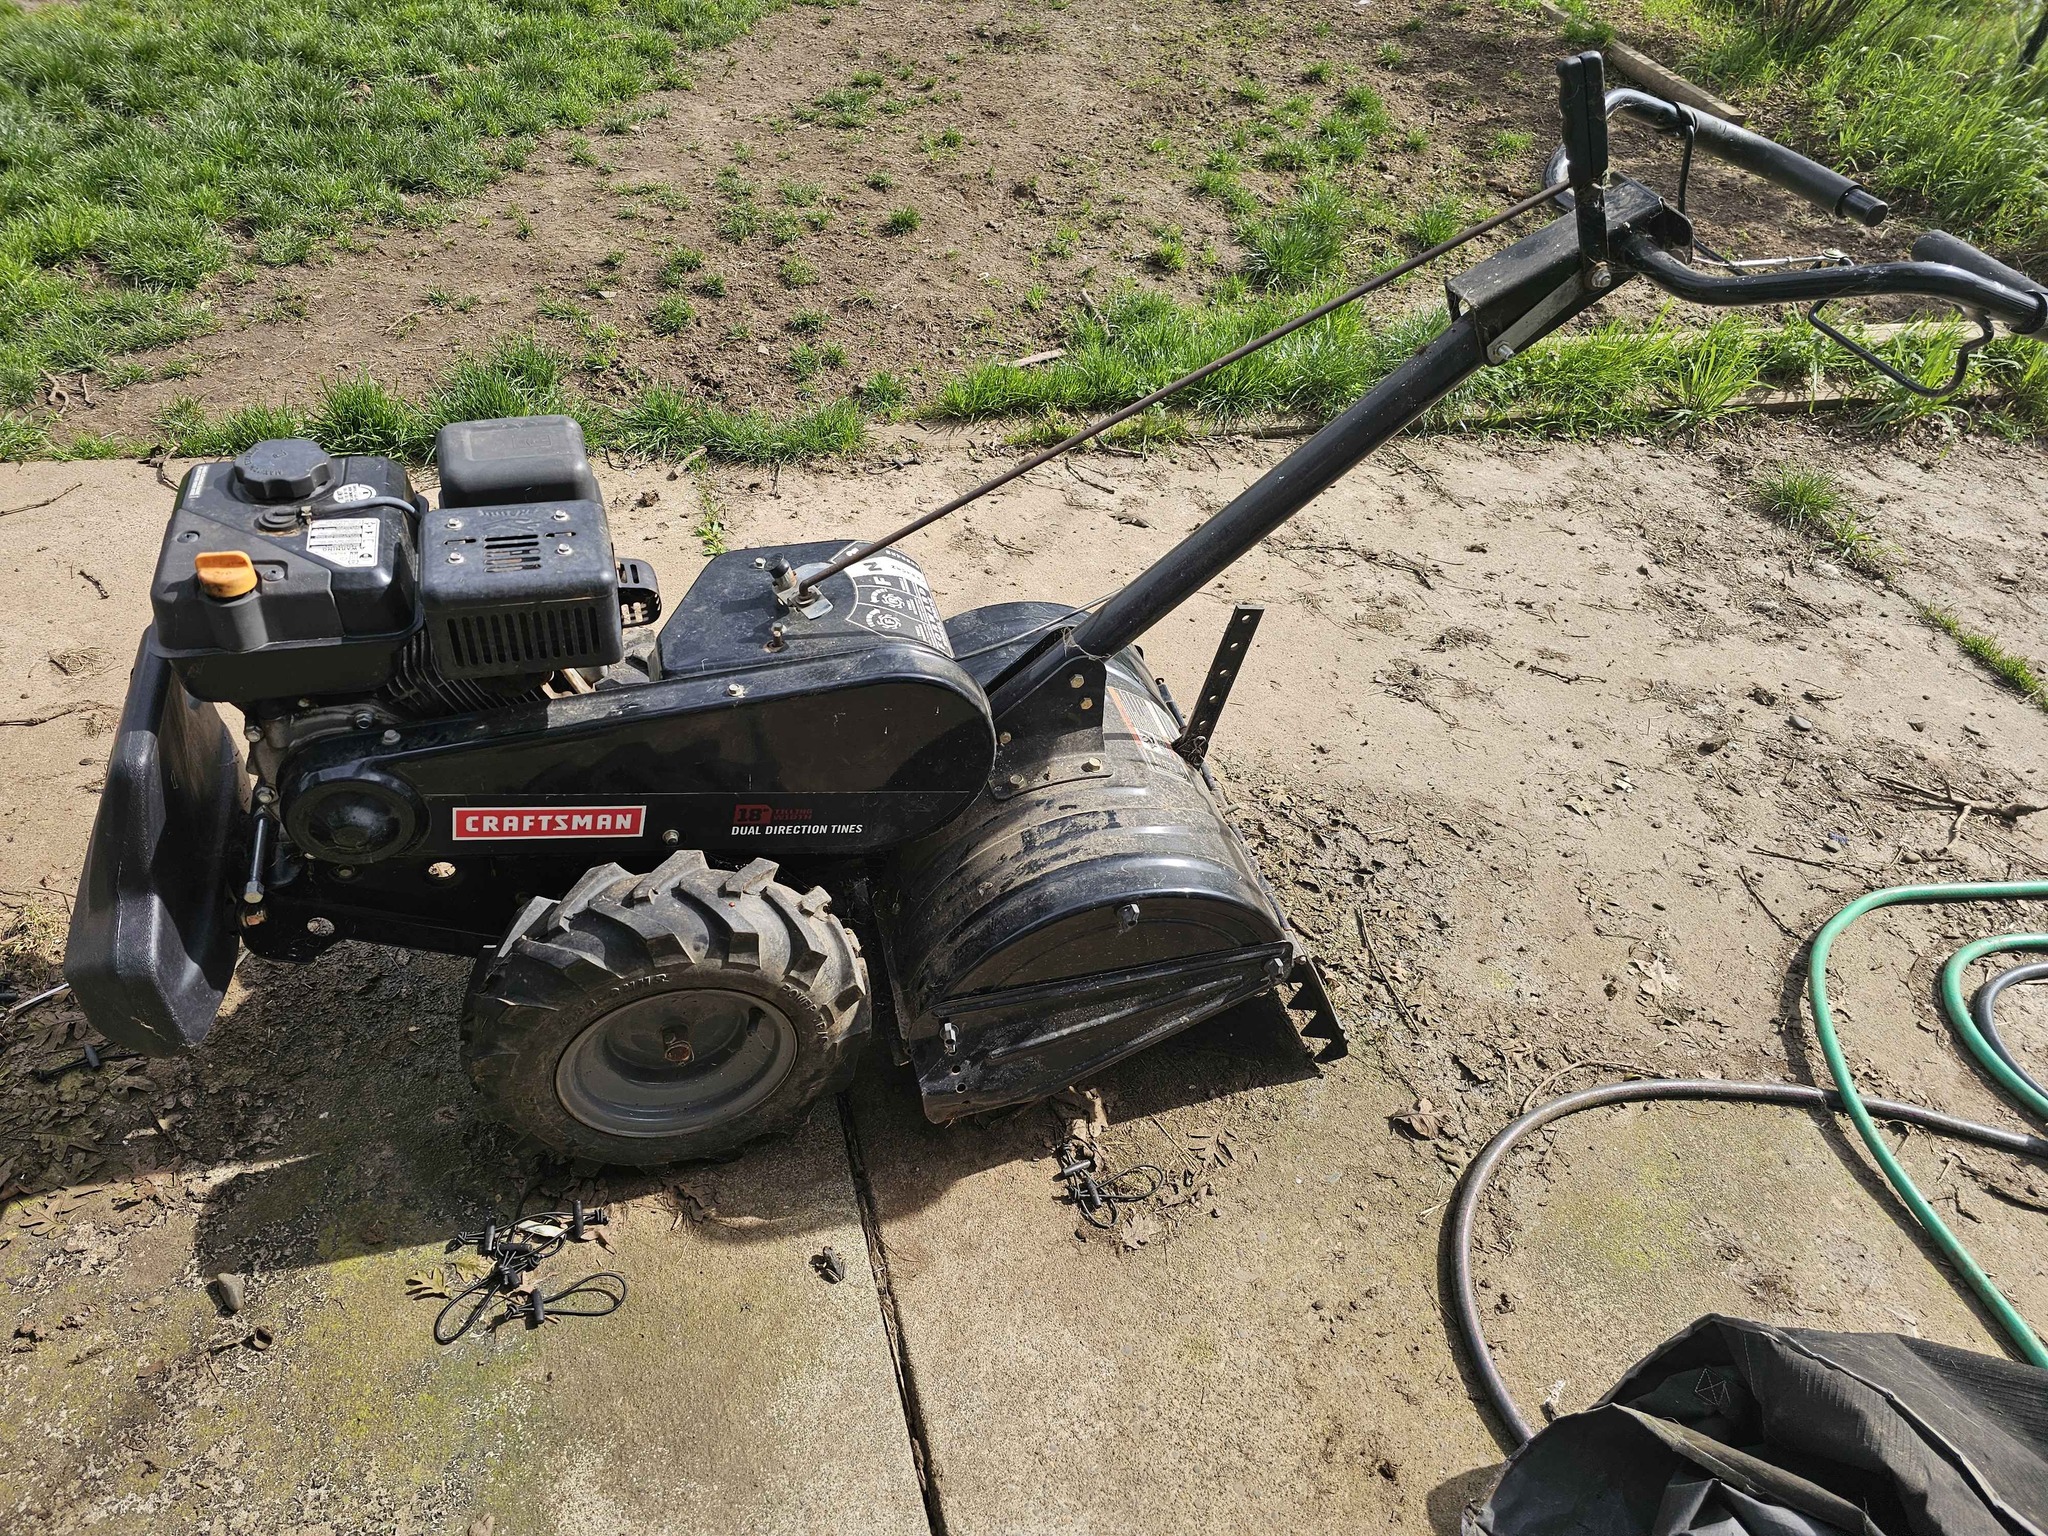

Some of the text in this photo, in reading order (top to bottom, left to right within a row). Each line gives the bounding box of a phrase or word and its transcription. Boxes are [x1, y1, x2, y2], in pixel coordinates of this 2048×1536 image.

[465, 813, 633, 833] CRAFTSMAN
[731, 824, 863, 836] DUAL DIRECTION TINES
